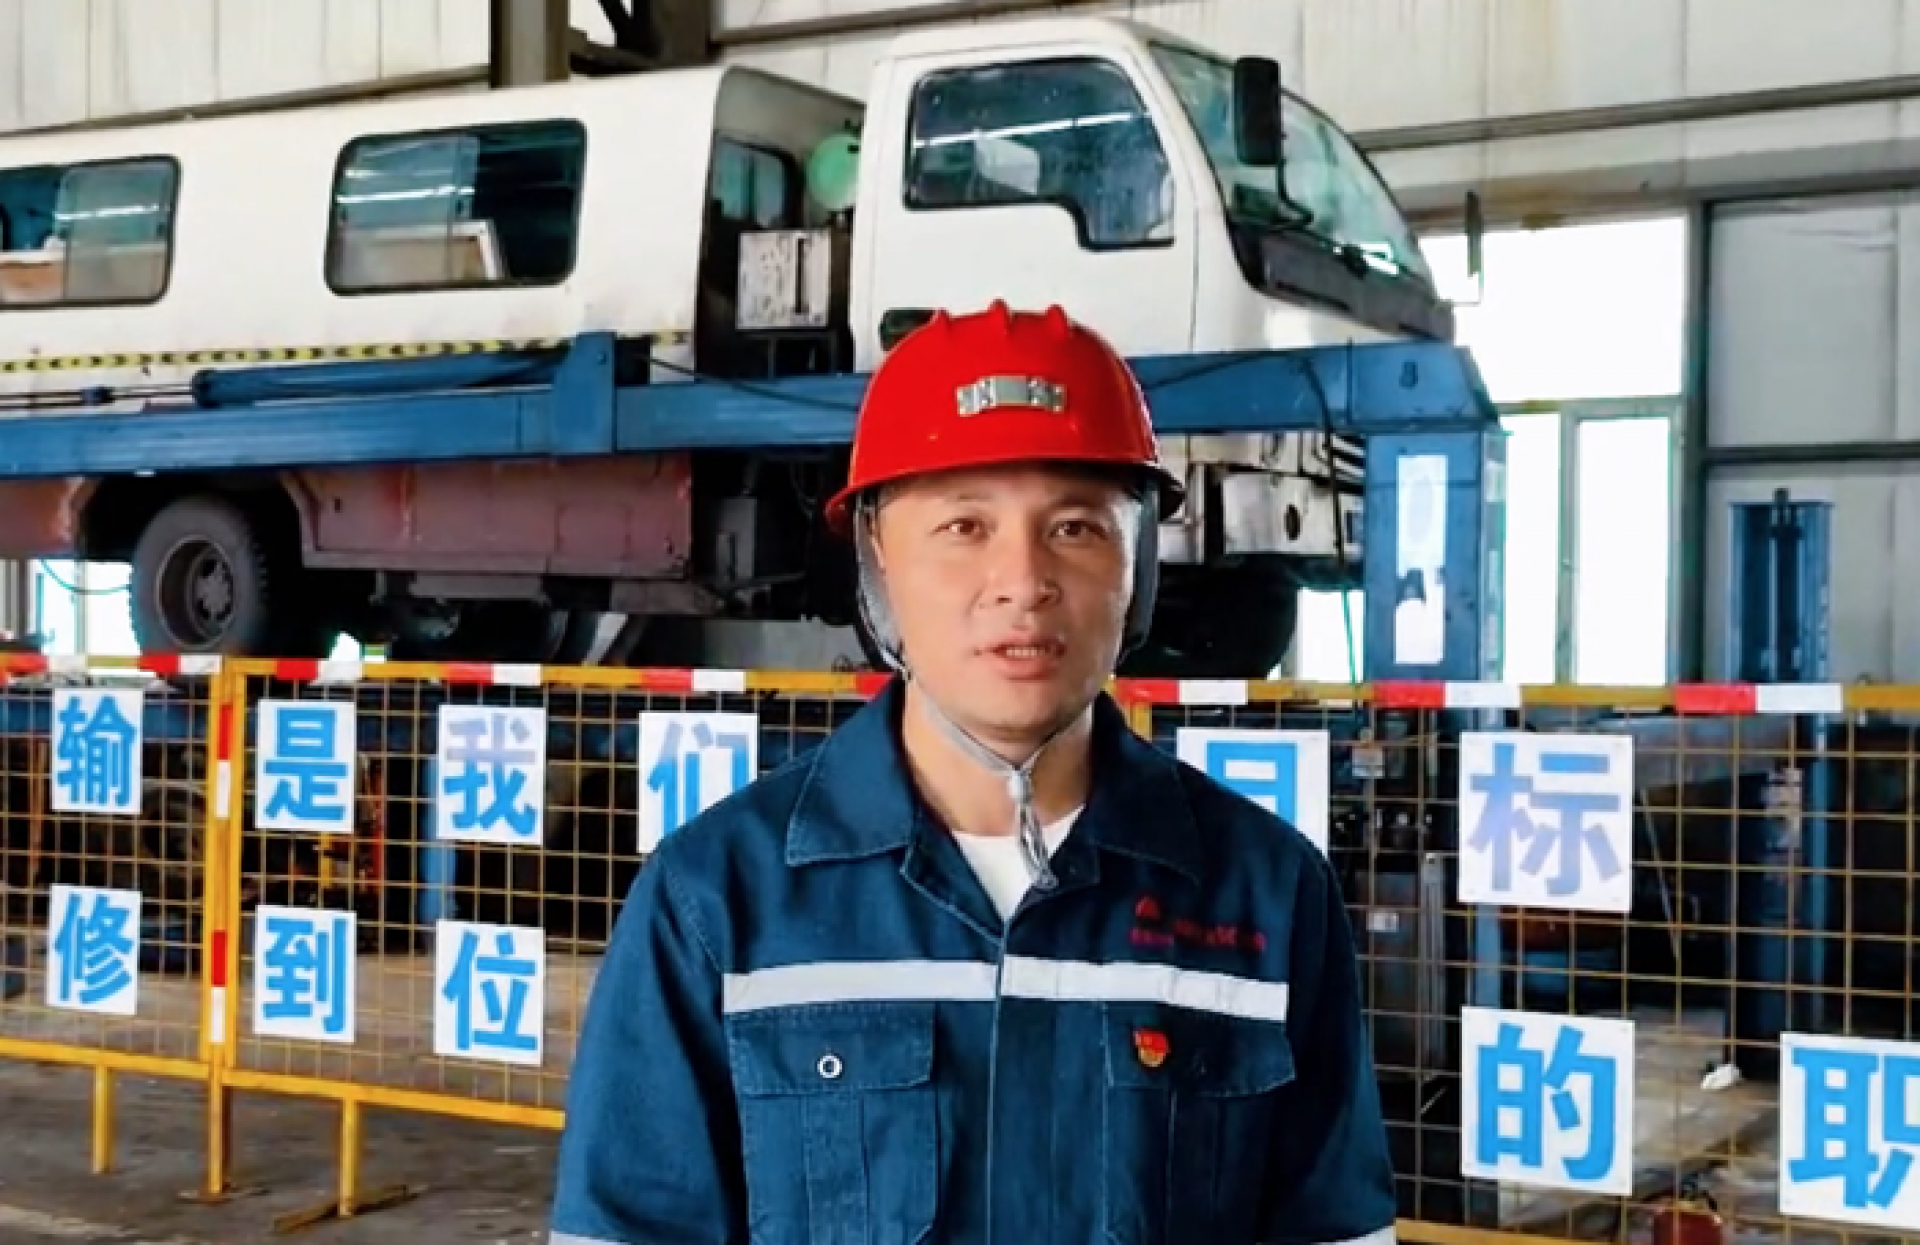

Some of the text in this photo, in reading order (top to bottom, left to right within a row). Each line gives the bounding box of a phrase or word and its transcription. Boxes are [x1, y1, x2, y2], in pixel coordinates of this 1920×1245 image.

[55, 696, 136, 807] 输
[264, 708, 349, 823] 是
[444, 713, 537, 836] 我
[1469, 742, 1620, 895] 标
[54, 894, 133, 1004] 修
[263, 918, 347, 1034] 到
[443, 931, 538, 1051] 位
[1472, 1022, 1617, 1180] 的
